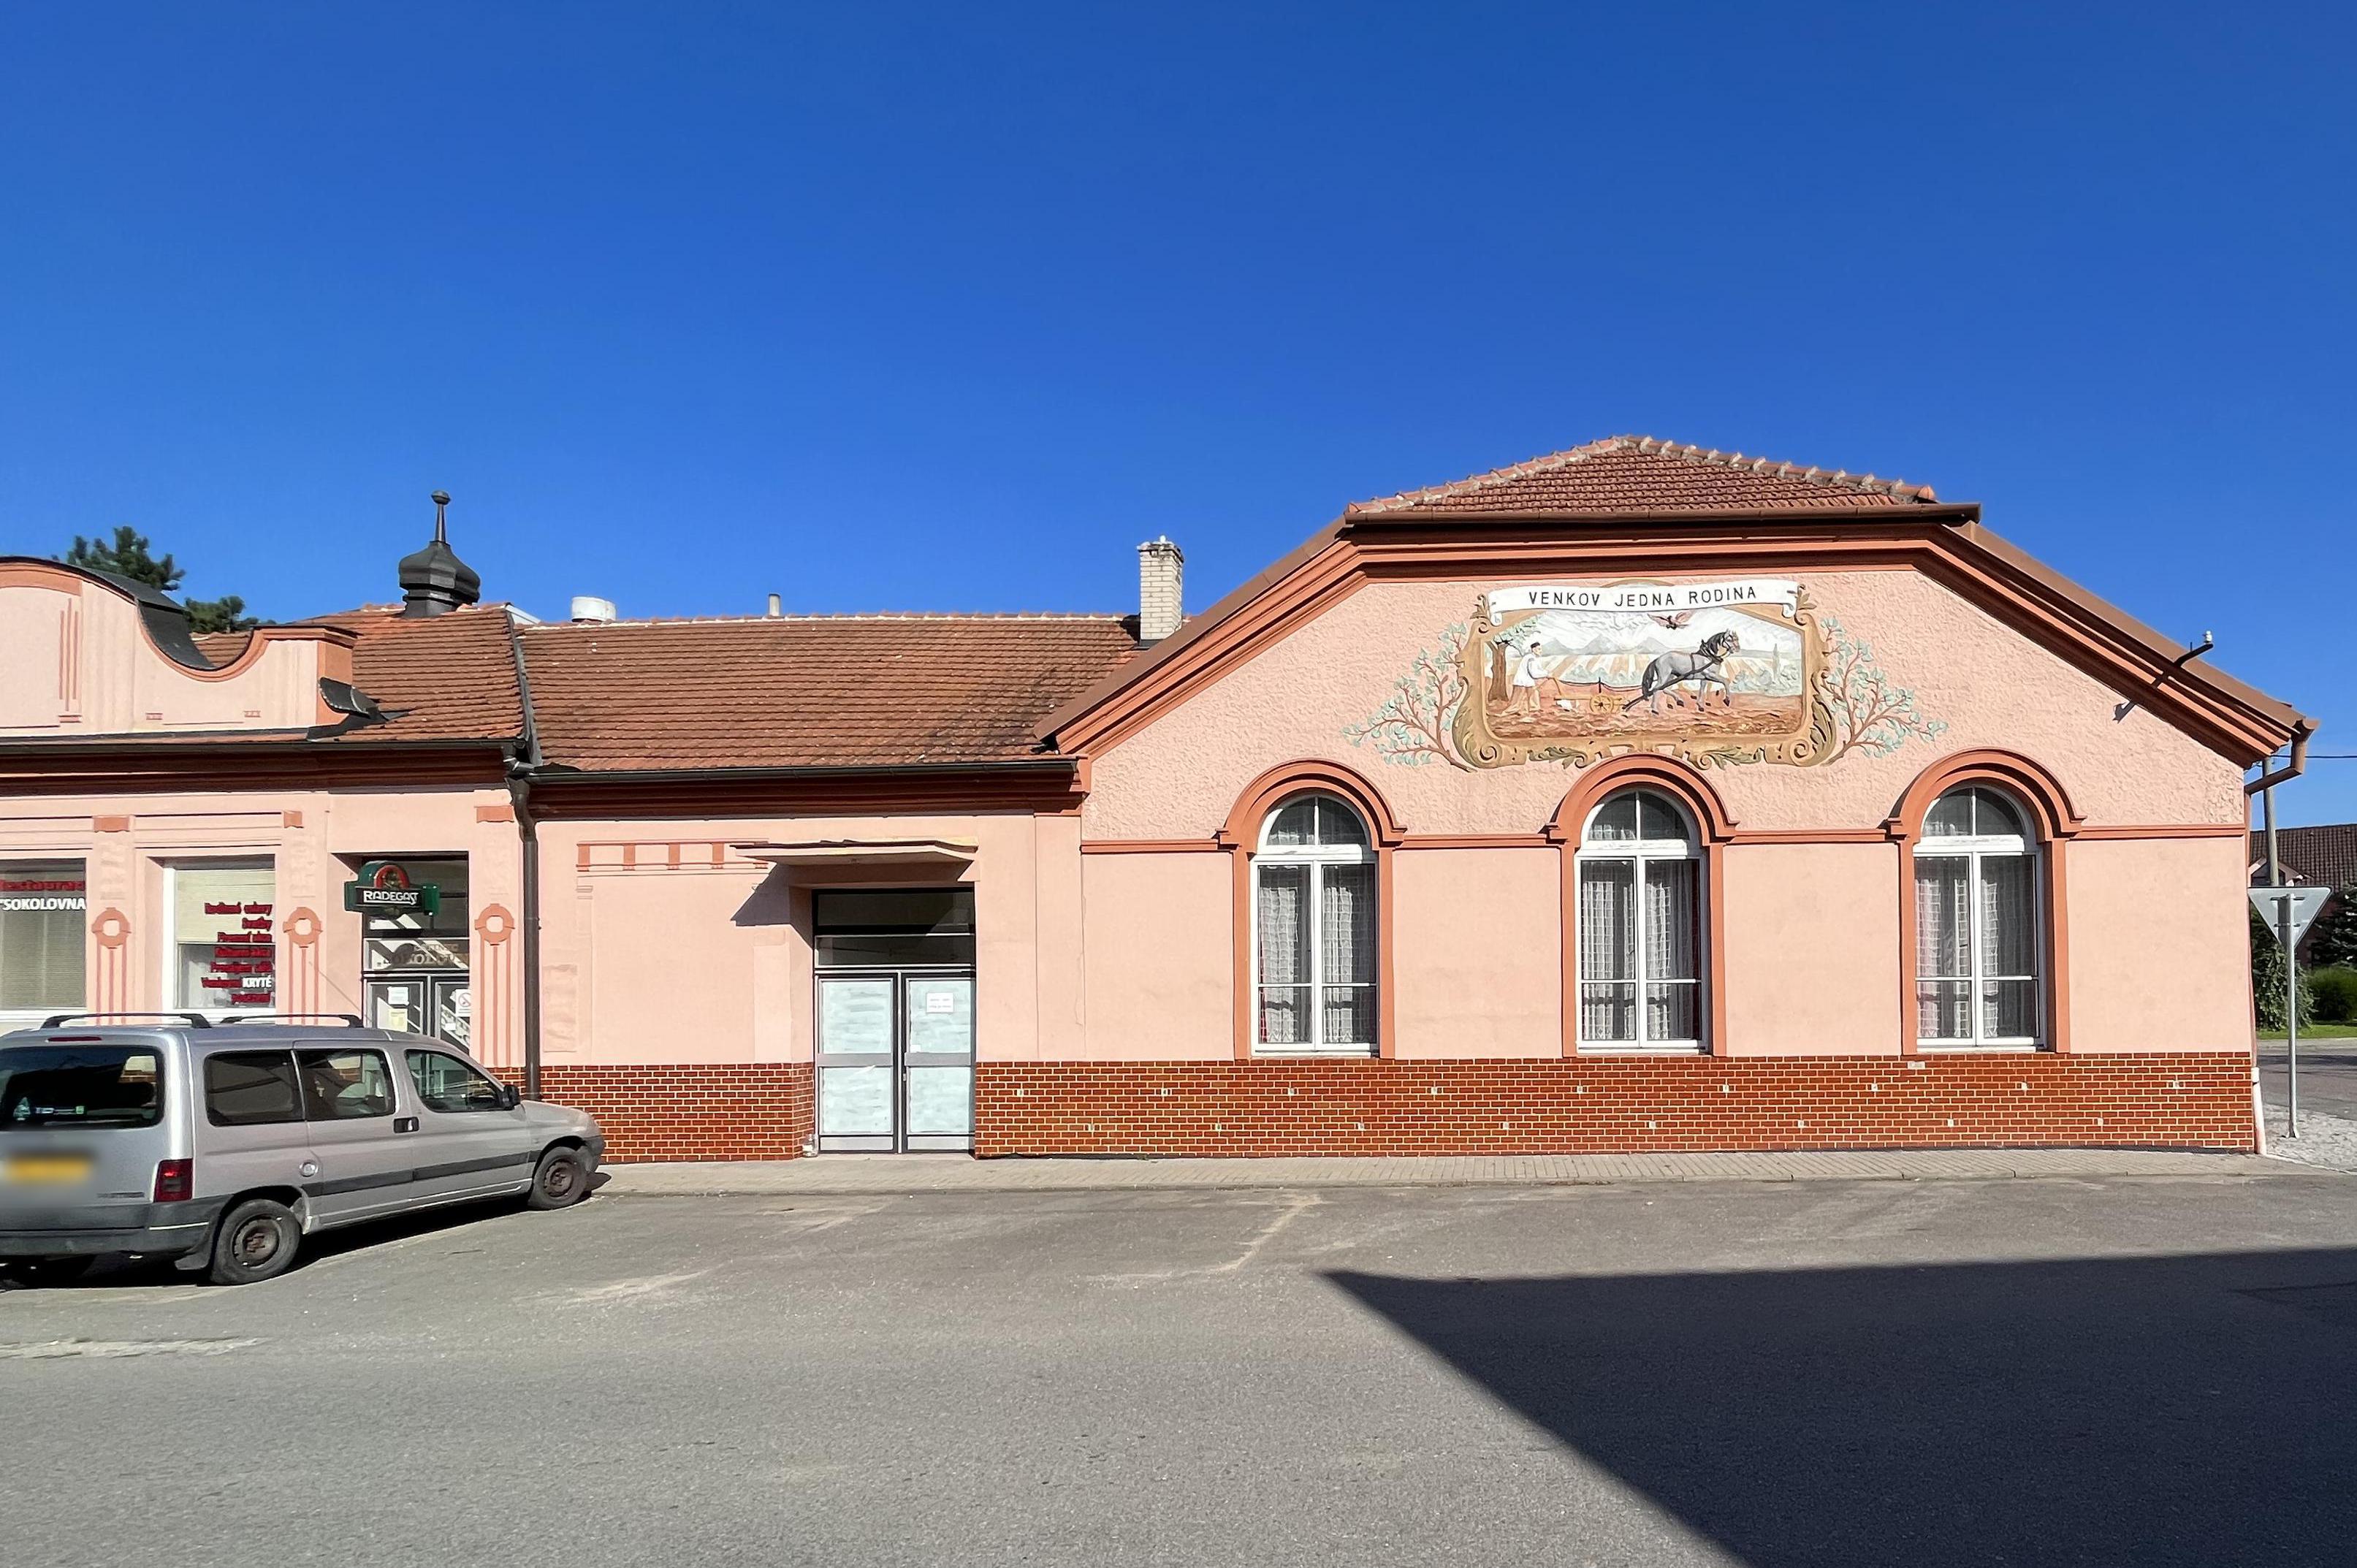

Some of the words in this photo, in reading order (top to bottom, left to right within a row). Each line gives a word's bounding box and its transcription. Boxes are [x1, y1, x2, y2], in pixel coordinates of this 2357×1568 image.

[1528, 591, 1600, 606] VENKOV
[1615, 593, 1675, 607] JEDNA
[1689, 586, 1756, 604] RODINA
[363, 890, 419, 905] RADEGAST
